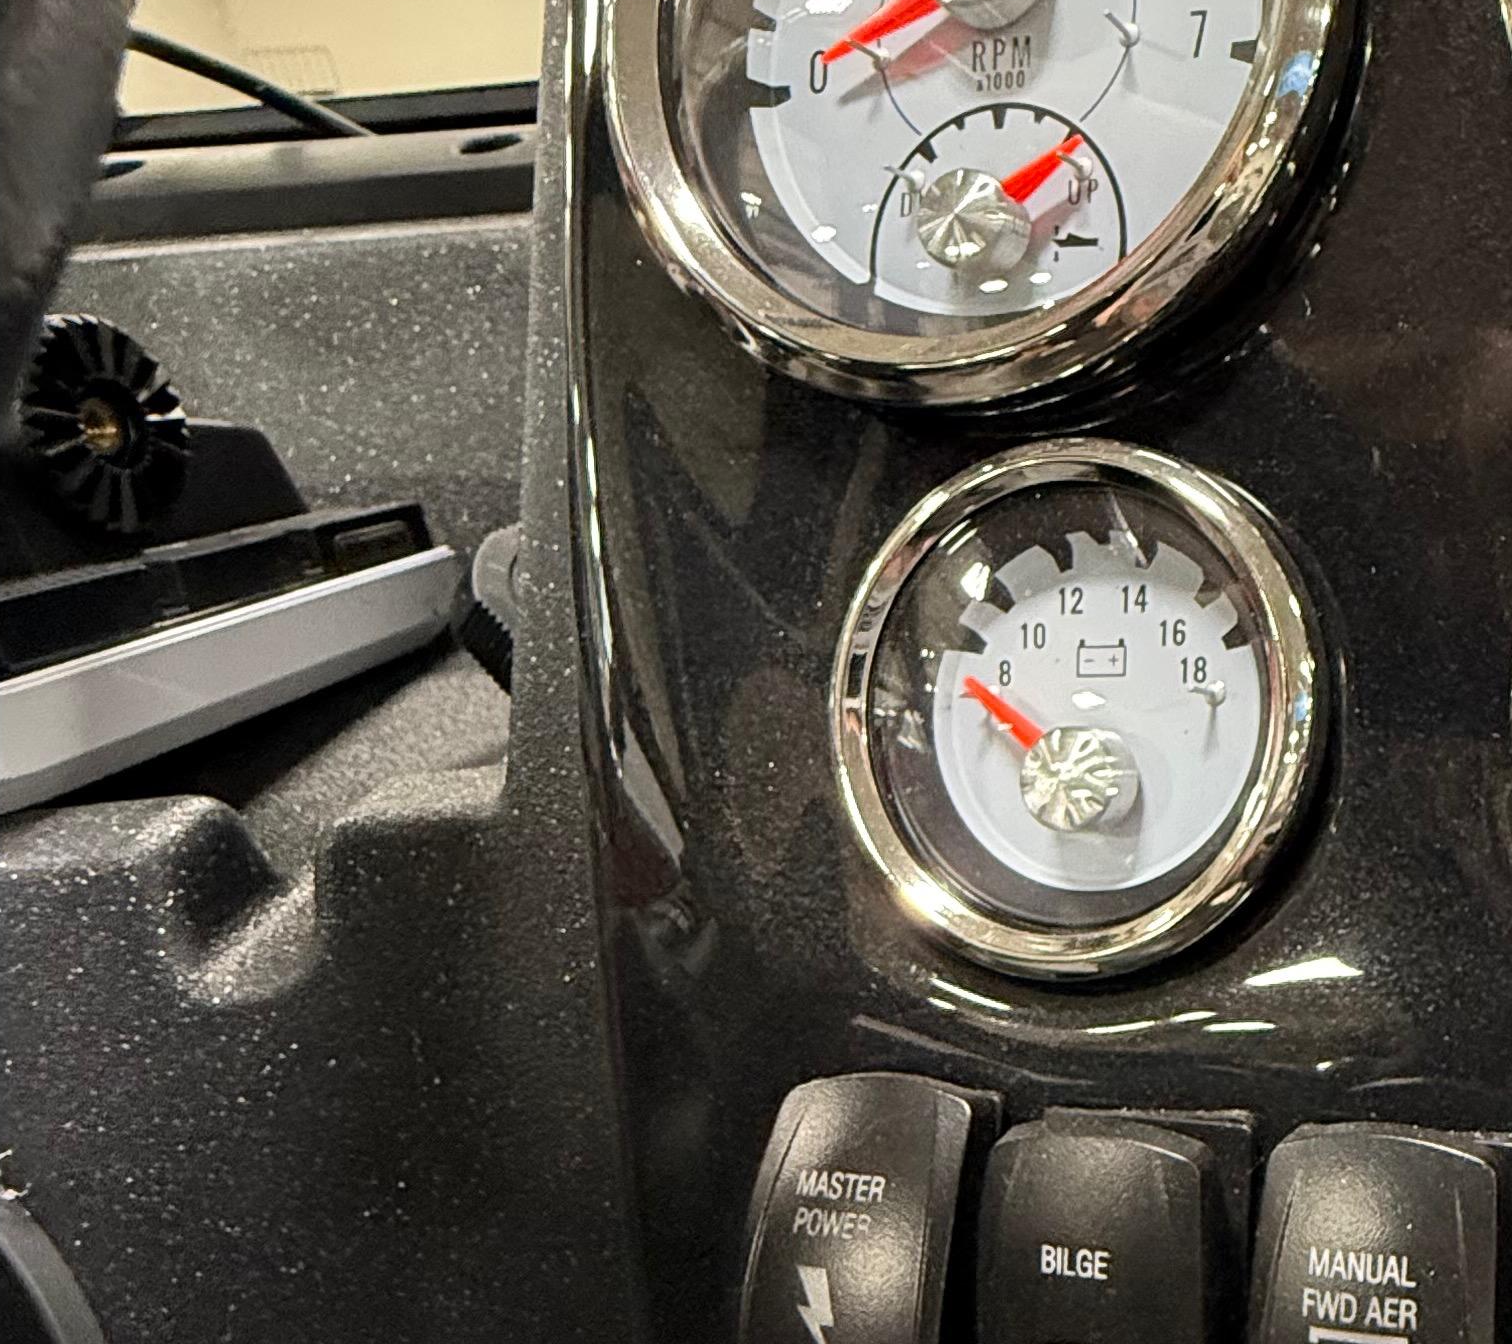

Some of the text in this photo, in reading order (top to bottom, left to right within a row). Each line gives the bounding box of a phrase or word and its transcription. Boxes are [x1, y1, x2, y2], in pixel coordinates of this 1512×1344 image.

[1190, 10, 1209, 58] 7
[972, 35, 1032, 72] RPM
[809, 51, 828, 94] 0
[1067, 177, 1099, 205] UP
[1059, 587, 1085, 616] 12
[1122, 584, 1148, 614] 14
[1021, 622, 1047, 649] 10
[1159, 618, 1187, 647] 16
[999, 660, 1012, 687] 8
[1180, 656, 1207, 684] 18
[796, 1170, 887, 1204] MASTER
[792, 1208, 872, 1241] POWER
[1040, 1244, 1110, 1281] BILGE
[1308, 1247, 1417, 1289] MANUAL
[1302, 1289, 1418, 1331] FWD AER
